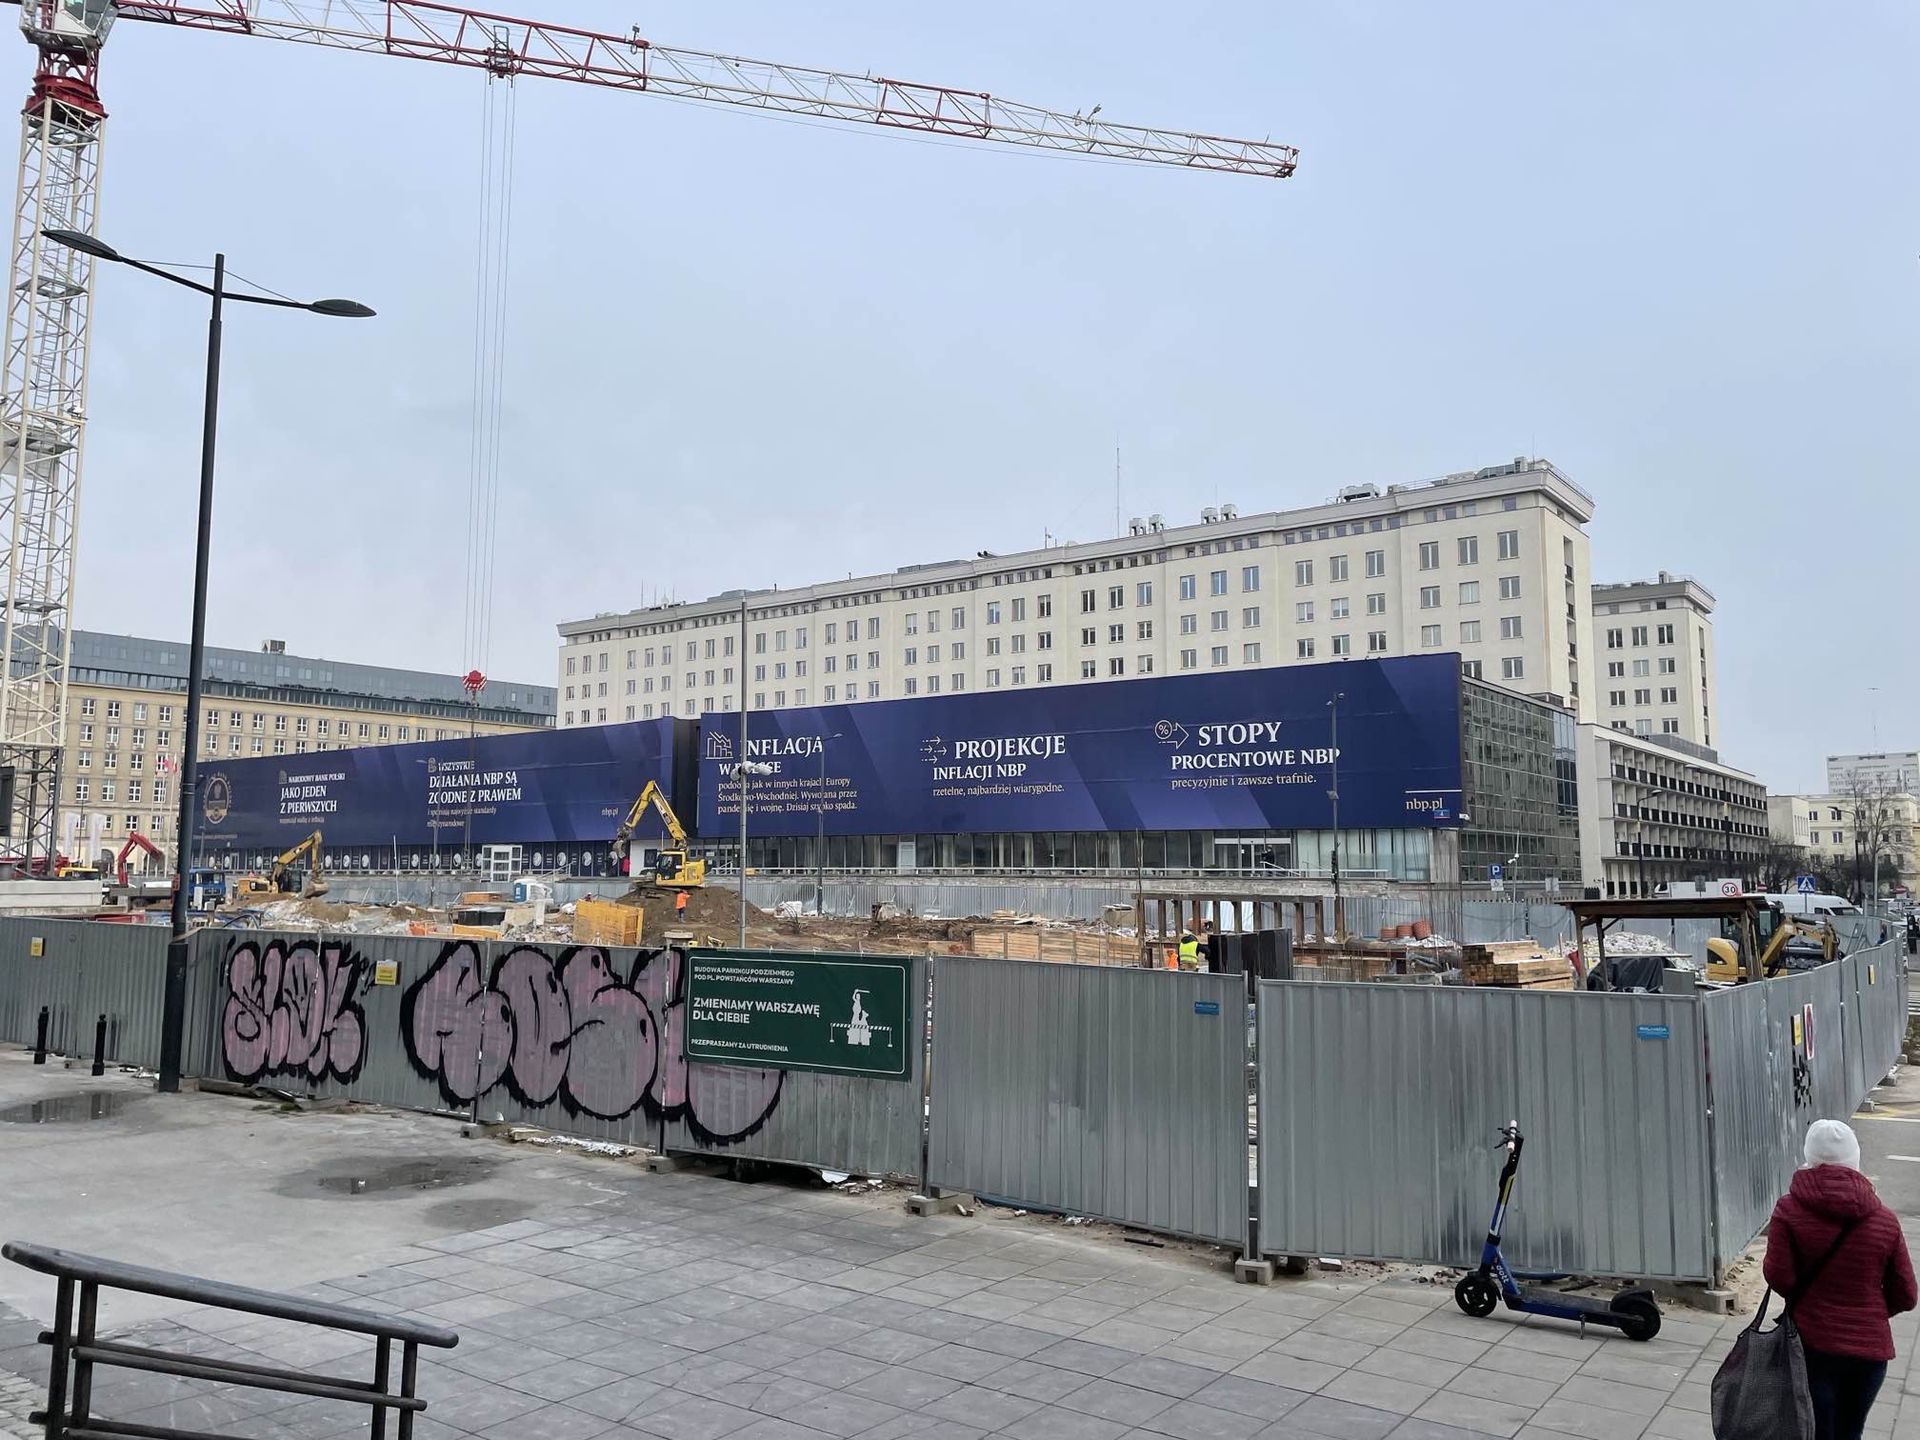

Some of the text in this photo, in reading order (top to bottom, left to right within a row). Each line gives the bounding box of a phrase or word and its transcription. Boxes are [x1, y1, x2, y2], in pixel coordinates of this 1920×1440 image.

[1199, 722, 1282, 746] STOPY
[740, 736, 823, 757] NFLACJA
[955, 735, 1065, 761] PROJEKCJE
[1171, 748, 1341, 770] PROCENTOWE NBP
[719, 763, 731, 776] W
[933, 763, 1026, 781] INFLACJI NBP
[429, 771, 517, 788] DZIAŁANIA NBP SĄ
[752, 780, 763, 790] jak
[774, 779, 797, 789] innych
[826, 777, 850, 787] Europy
[1171, 772, 1317, 790] precyzyjnie i zawsze trafnie.
[281, 785, 327, 801] JAKO JEDEN
[470, 790, 476, 802] Z
[478, 788, 521, 802] PRAWEM
[839, 791, 857, 799] przez
[933, 782, 1064, 796] rzetelne, najbardziej wiarygodne.
[280, 800, 337, 814] Z PIERWSZYCH
[786, 803, 809, 813] Dzisiaj
[1406, 798, 1443, 811] nbp.pl
[1492, 866, 1499, 875] P
[694, 966, 721, 974] BUDOWA
[759, 977, 794, 985] WARSZAWY
[693, 997, 820, 1018] ZMIENIAMY WARSZAWĘ
[692, 1010, 750, 1024] DLA CIEBIE
[691, 1038, 737, 1048] PRZEPRASZAMY
[747, 1043, 788, 1052] UTRUDNIENIA
